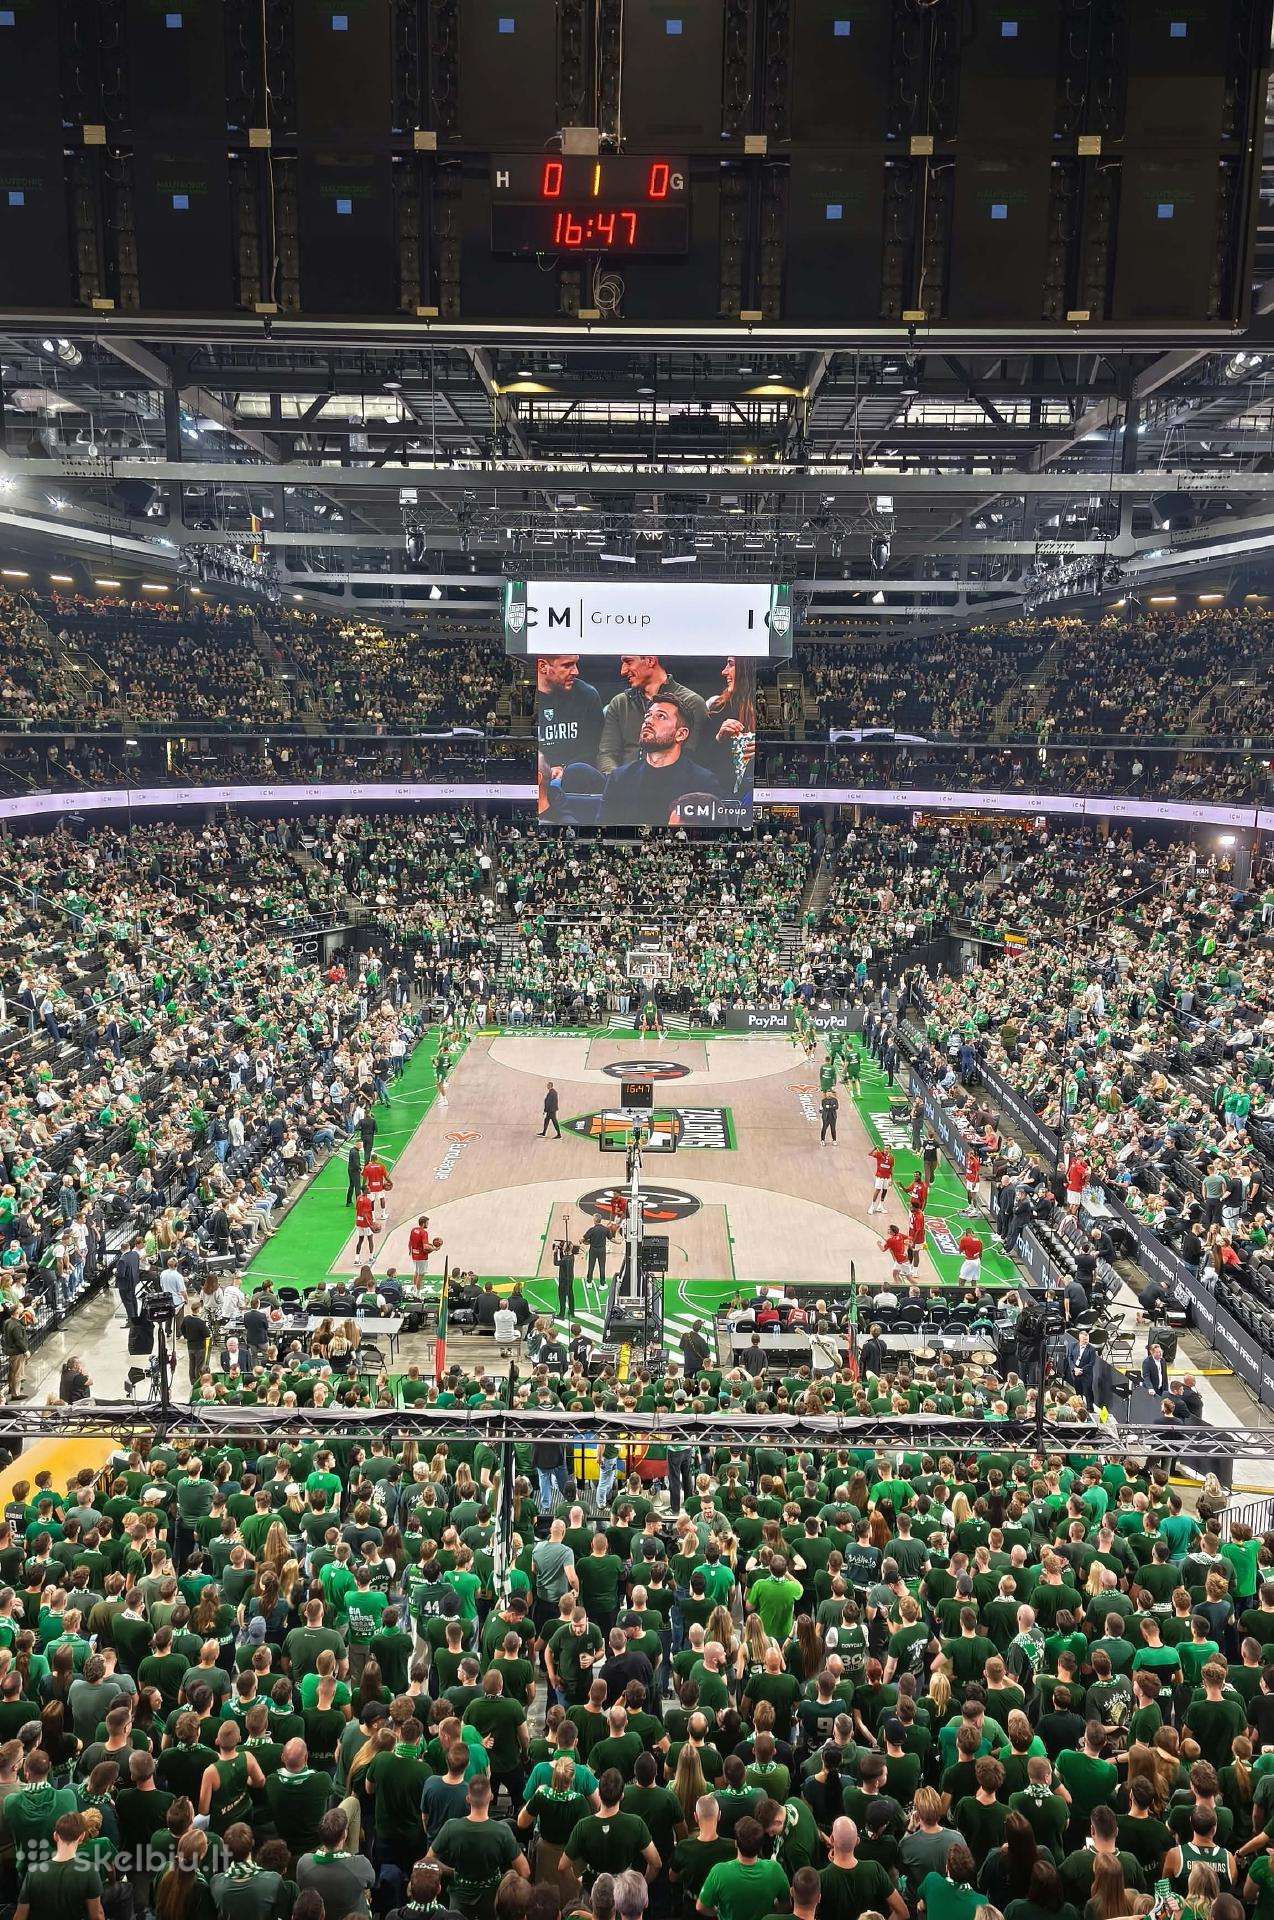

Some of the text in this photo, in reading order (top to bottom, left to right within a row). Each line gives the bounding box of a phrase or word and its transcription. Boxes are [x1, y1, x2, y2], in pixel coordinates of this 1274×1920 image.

[496, 171, 510, 188] H
[543, 163, 563, 196] 0
[649, 164, 669, 197] 0
[670, 173, 684, 190] G
[554, 212, 638, 245] 16:47
[591, 611, 652, 629] Group
[676, 804, 747, 816] ICM Group
[748, 1014, 788, 1028] PayPal
[626, 1084, 651, 1094] 16:47
[547, 1352, 558, 1362] 44
[424, 1600, 440, 1614] 44
